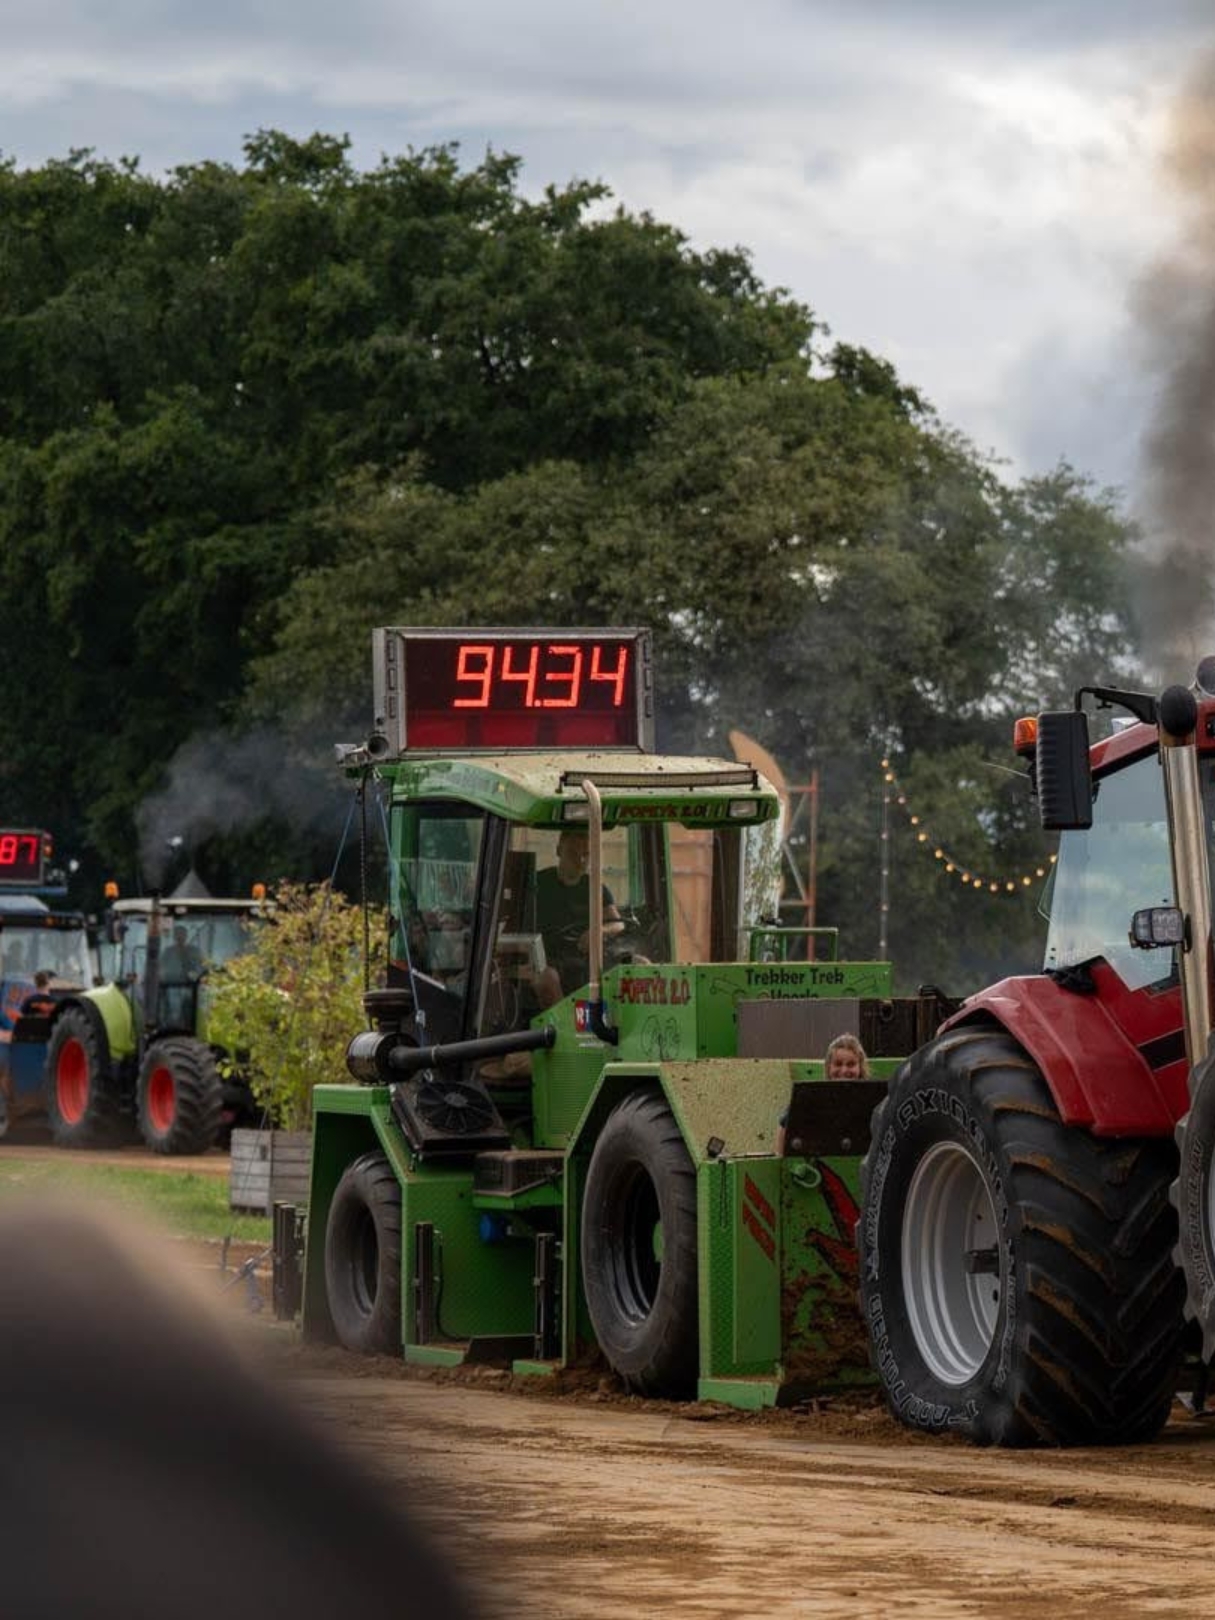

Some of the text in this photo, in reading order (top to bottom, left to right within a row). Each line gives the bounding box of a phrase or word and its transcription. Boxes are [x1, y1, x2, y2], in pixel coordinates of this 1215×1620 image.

[453, 645, 628, 708] 94.34
[745, 966, 845, 985] Trekker Trek
